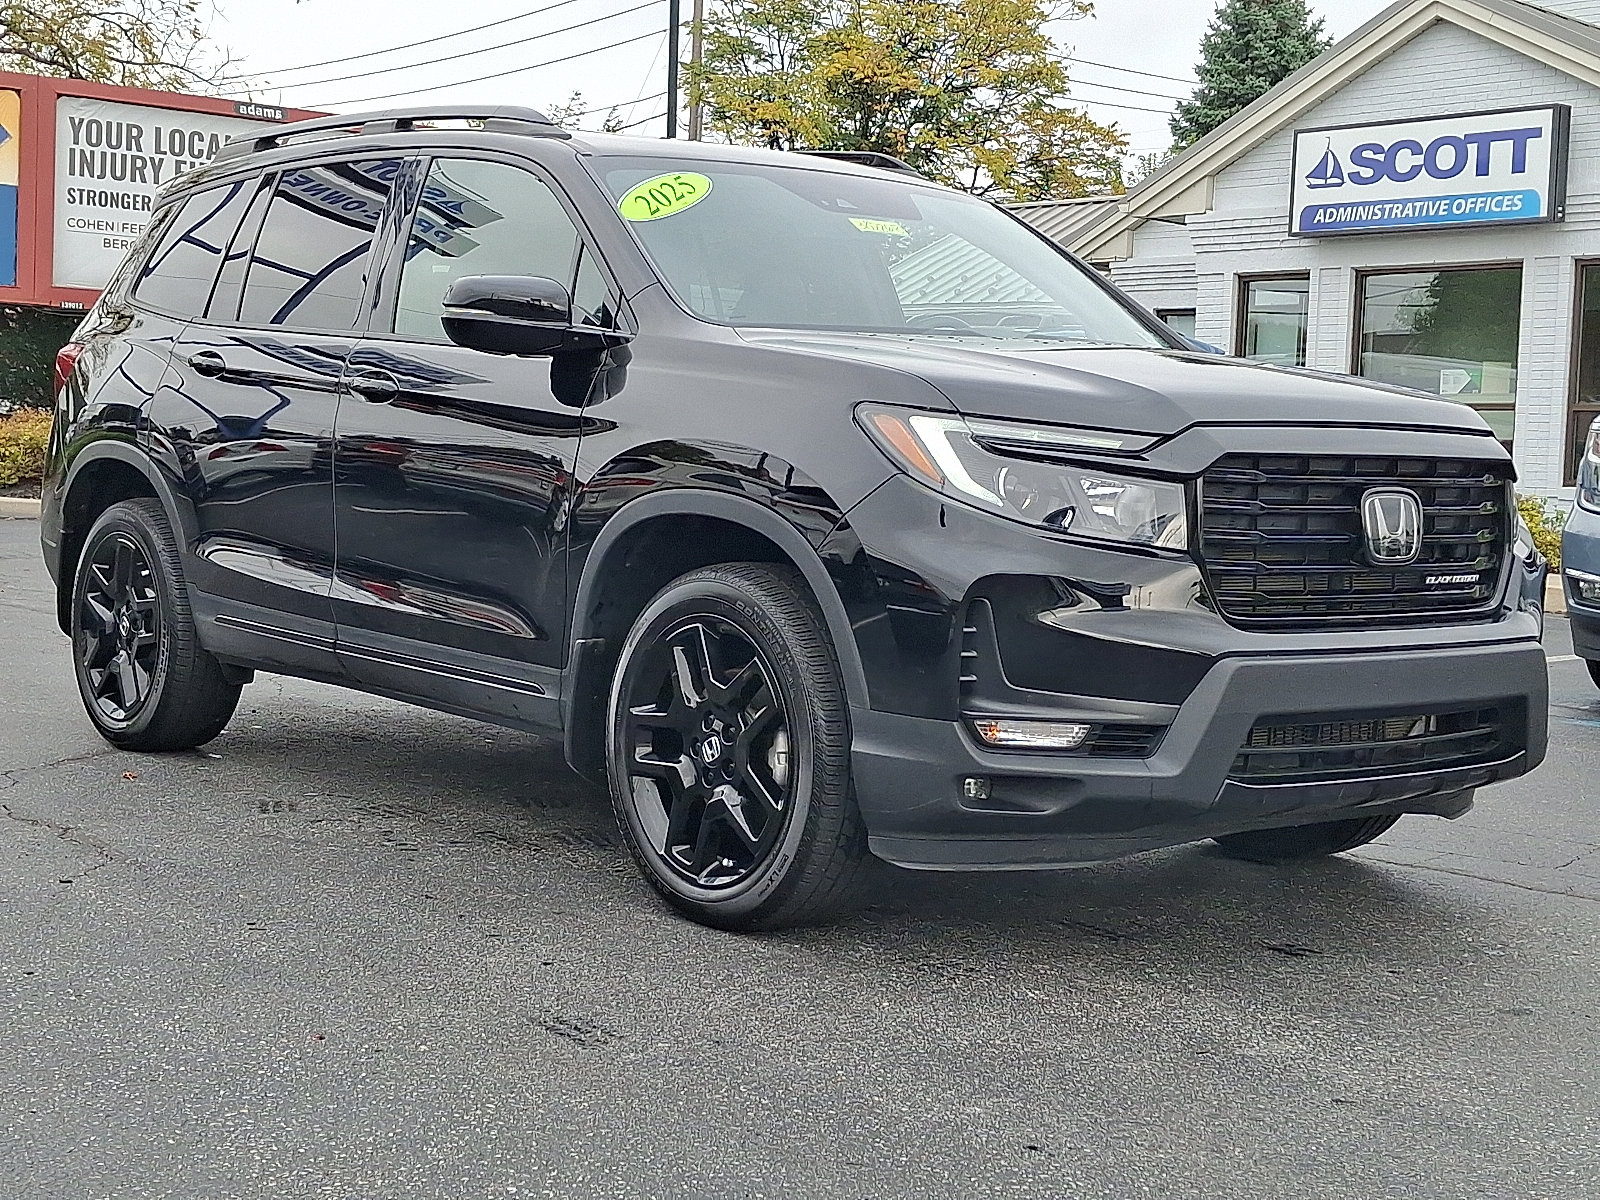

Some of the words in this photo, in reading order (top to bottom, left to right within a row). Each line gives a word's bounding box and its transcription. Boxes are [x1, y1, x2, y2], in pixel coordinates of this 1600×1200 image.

[239, 104, 283, 119] adams
[68, 116, 144, 152] YOUR
[68, 148, 164, 185] INJURY
[1348, 126, 1543, 186] SCOTT
[67, 187, 152, 212] STRONGER
[633, 175, 697, 216] 2025
[1313, 199, 1449, 224] ADMINISTRATIVE
[1452, 194, 1524, 215] OFFICES
[67, 217, 115, 231] COHEN
